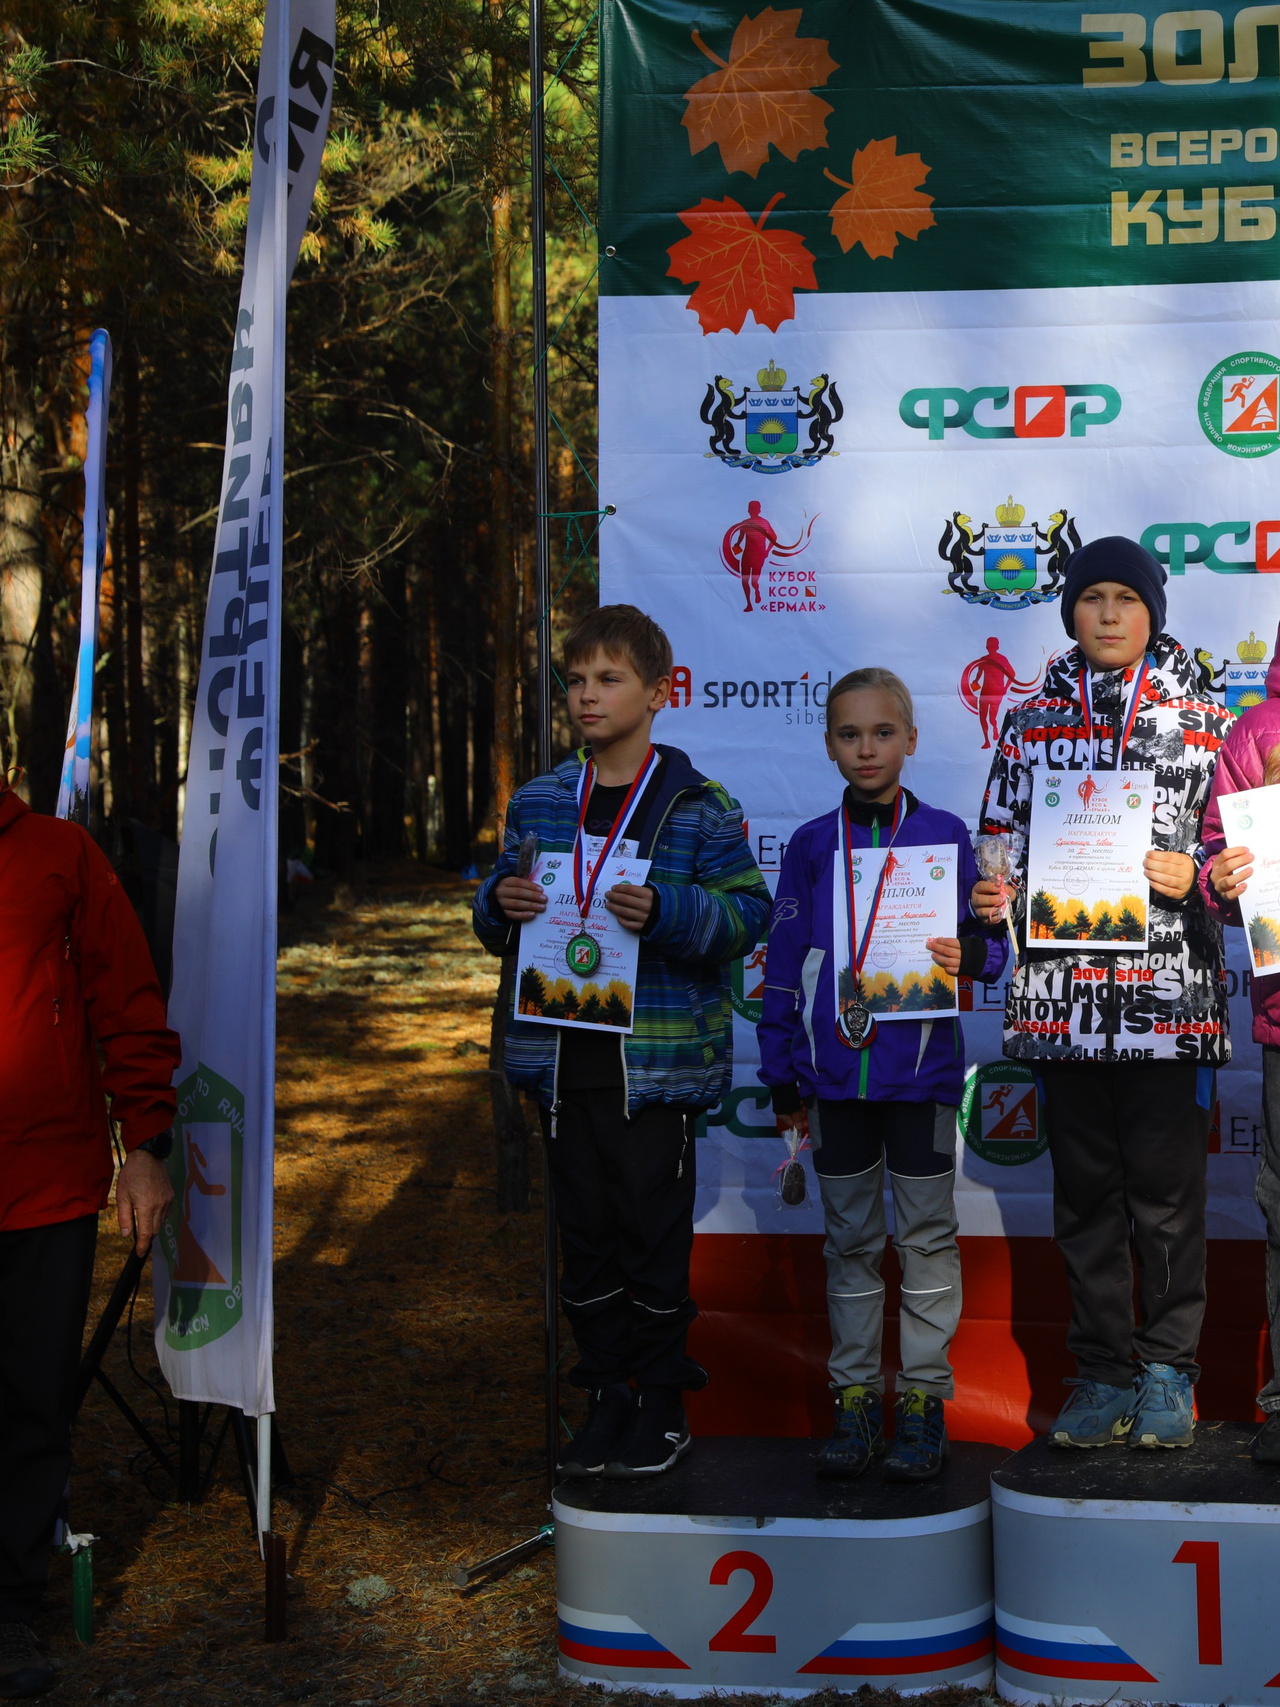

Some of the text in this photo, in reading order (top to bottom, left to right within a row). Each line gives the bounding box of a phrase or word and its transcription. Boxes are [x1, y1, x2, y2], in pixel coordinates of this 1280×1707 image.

[1203, 366, 1227, 408] ФЕДЕРАЦИЯ
[1203, 411, 1223, 442] ОБЛАСТИ
[1227, 442, 1273, 454] ТЮМЕНСКОЙ
[768, 571, 816, 582] КУБОК
[768, 586, 799, 597] КСО
[760, 602, 826, 613] «ЕРМАК»
[703, 671, 831, 708] SPORTid
[785, 709, 826, 725] sibe
[1063, 813, 1122, 826] ДИПЛОМ
[866, 887, 926, 901] ИПЛОМ
[988, 1065, 1033, 1078] СПОРТИВНО
[708, 1549, 777, 1654] 2
[1171, 1540, 1222, 1665] 1
